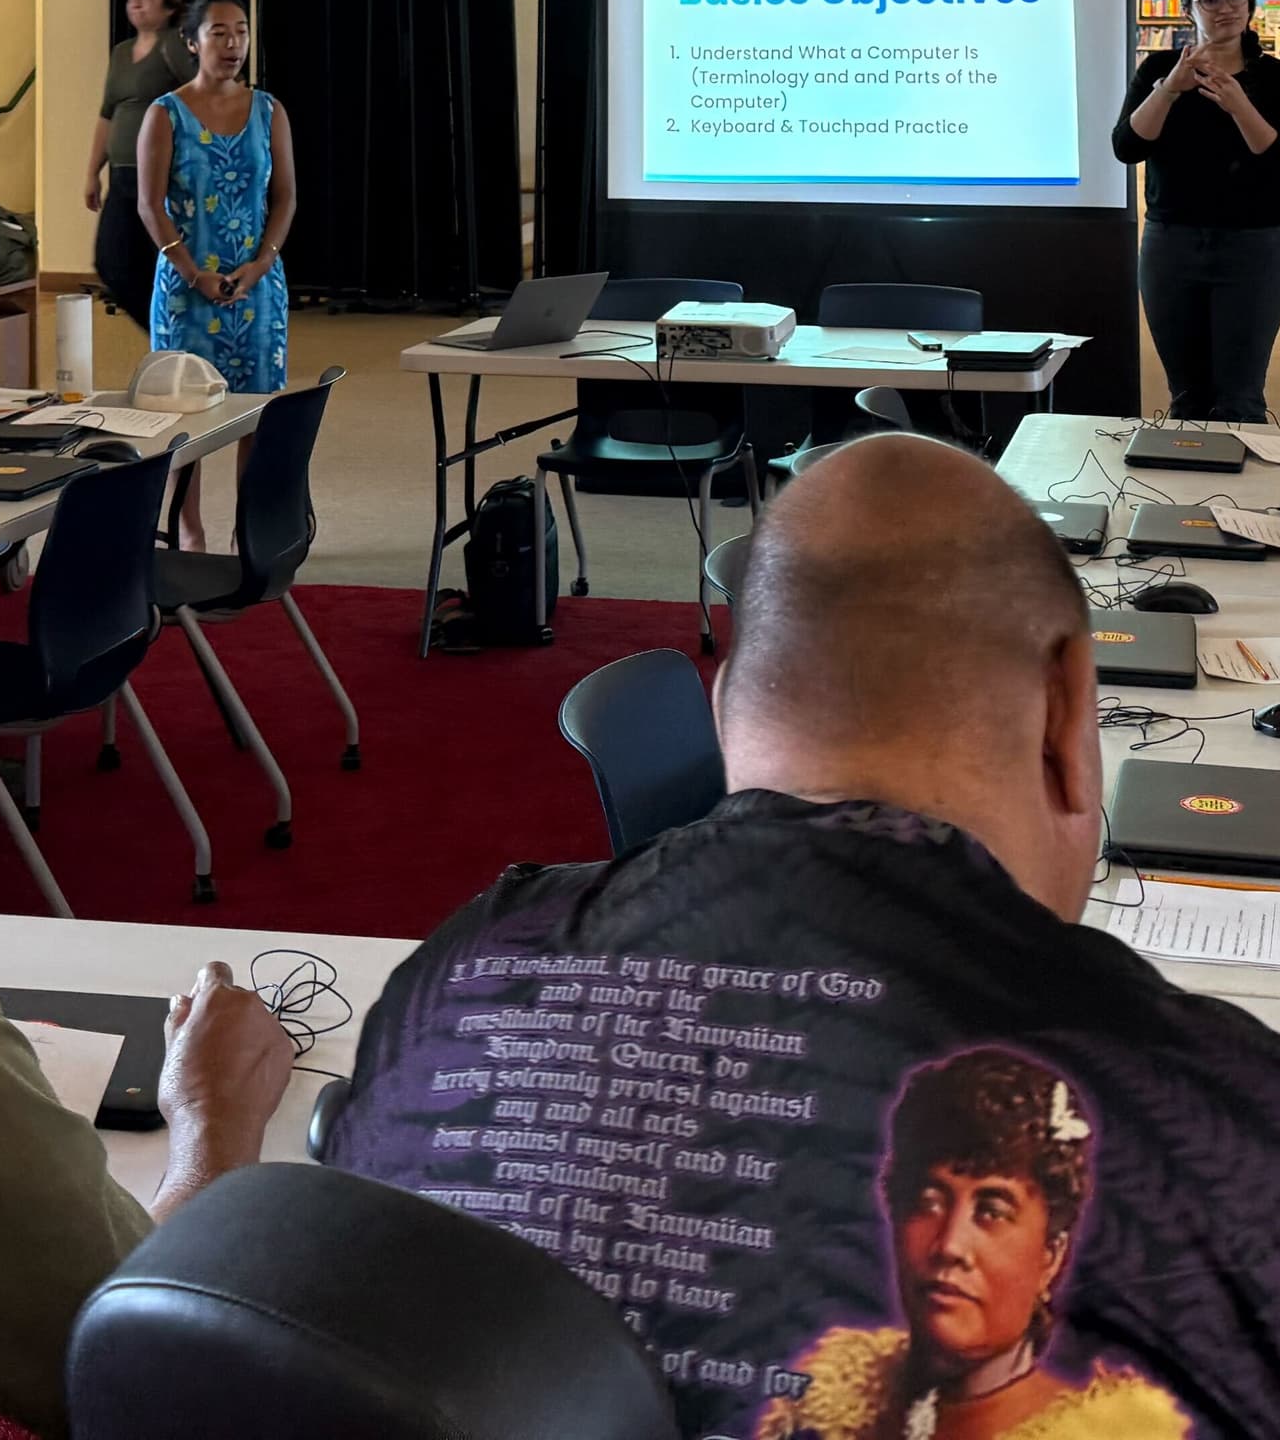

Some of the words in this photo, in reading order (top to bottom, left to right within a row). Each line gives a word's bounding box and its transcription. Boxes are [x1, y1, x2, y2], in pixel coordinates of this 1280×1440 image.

[669, 45, 680, 60] 1.
[690, 44, 794, 61] Understand
[798, 44, 847, 61] What
[851, 49, 862, 60] a
[867, 45, 959, 64] Computer
[964, 45, 979, 60] Is
[691, 67, 809, 89] (Terminology
[814, 68, 849, 85] and
[854, 68, 890, 85] and
[895, 68, 940, 85] Parts
[945, 68, 963, 85] of
[967, 68, 998, 85] the
[690, 91, 788, 113] Computer)
[666, 118, 681, 134] 2.
[690, 117, 776, 138] Keyboard
[780, 119, 794, 134] &
[798, 117, 890, 138] Touchpad
[894, 117, 969, 135] Practice
[539, 981, 584, 1003] and
[589, 983, 663, 1008] under
[668, 988, 708, 1013] the
[620, 956, 651, 983] by
[657, 957, 697, 982] the
[701, 965, 775, 991] grace
[781, 970, 815, 997] of
[819, 971, 883, 1000] God
[581, 1011, 614, 1037] of
[613, 1013, 653, 1037] the
[658, 1015, 807, 1055] Hawaiian
[714, 1055, 750, 1080] do
[494, 1067, 602, 1099] solemnly
[608, 1075, 702, 1107] protest
[709, 1090, 817, 1120] against
[495, 1099, 539, 1125] any
[543, 1100, 594, 1124] and
[600, 1105, 637, 1130] all
[642, 1112, 700, 1138] acts
[480, 1127, 570, 1154] against
[575, 1135, 673, 1170] myself
[673, 1149, 727, 1174] and
[735, 1153, 778, 1182] the
[495, 1160, 669, 1200] constitutional
[539, 1193, 572, 1221] of
[573, 1196, 614, 1224] the
[623, 1201, 774, 1250] Hawaiian
[570, 1229, 605, 1262] by
[612, 1239, 708, 1274] certain
[629, 1271, 659, 1300] to
[666, 1277, 737, 1313] have
[661, 1350, 699, 1380] of
[700, 1357, 756, 1388] and
[763, 1364, 812, 1398] for
